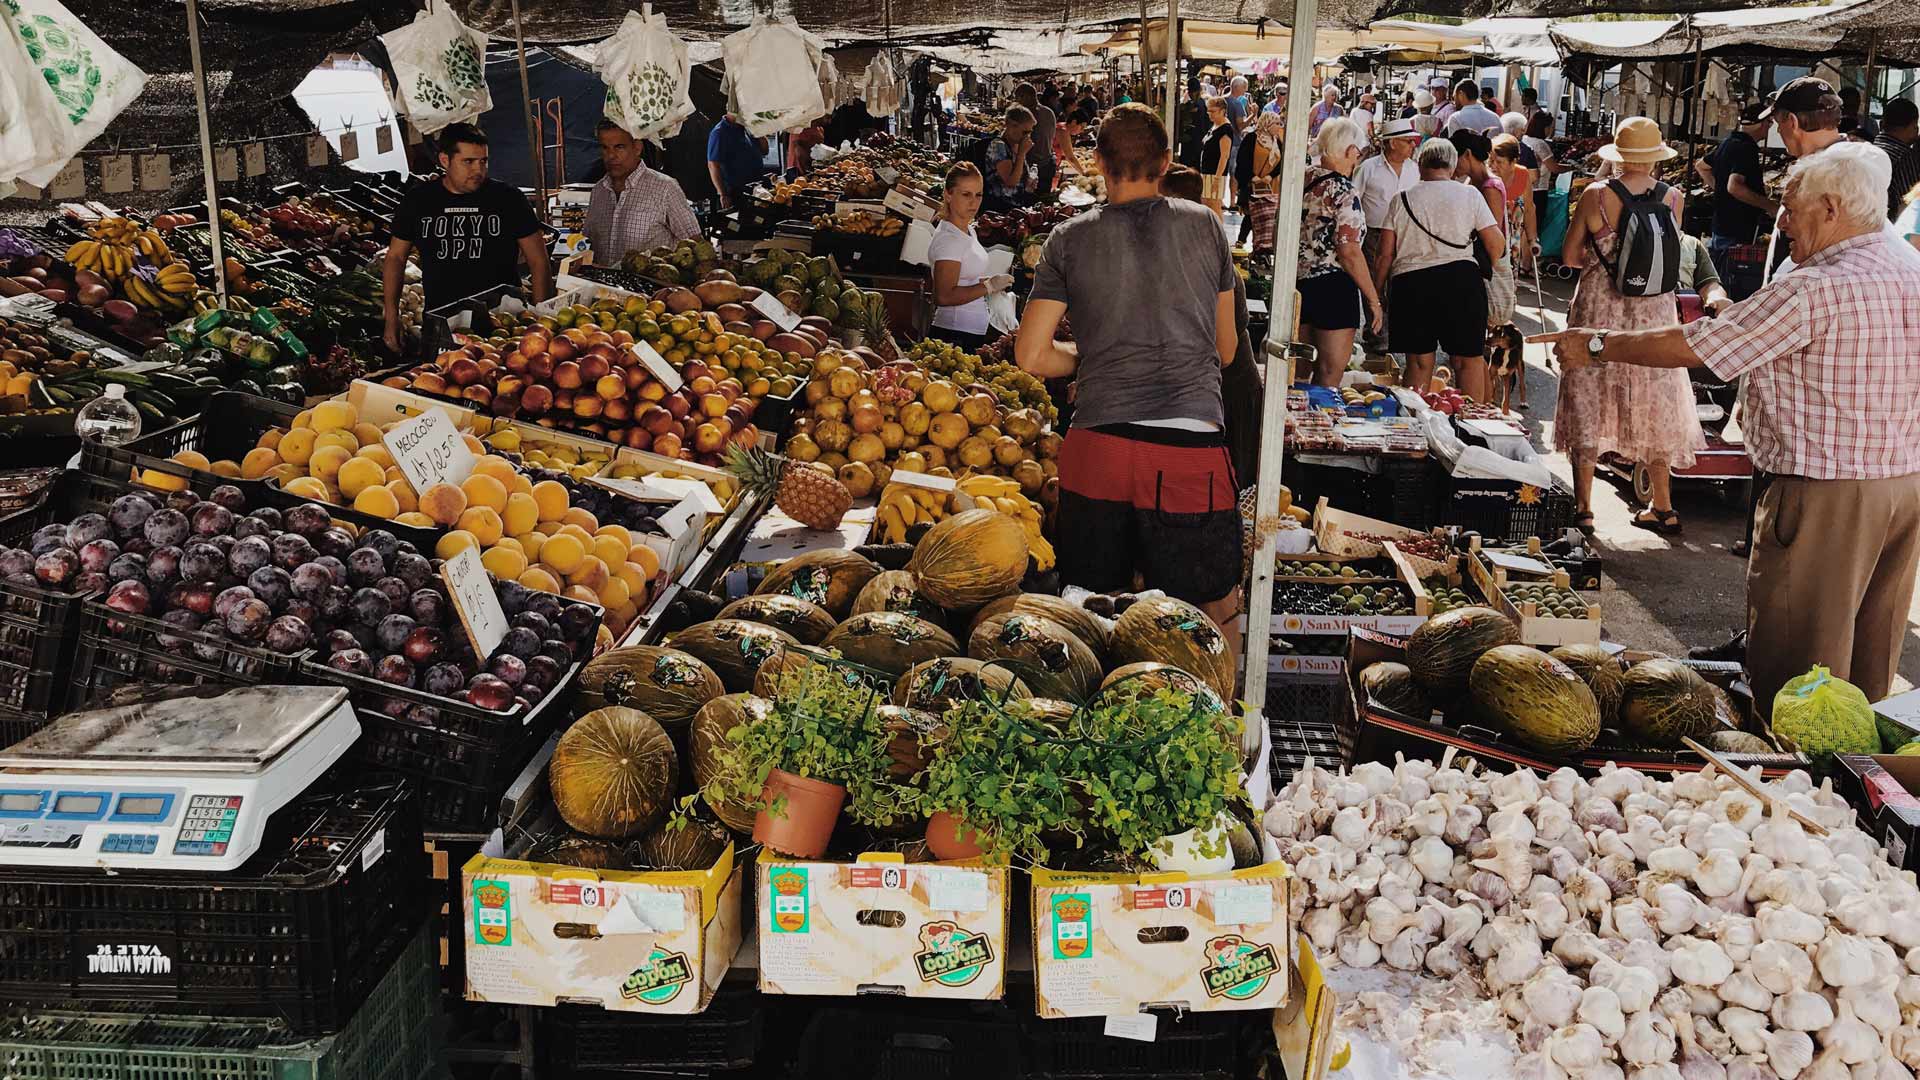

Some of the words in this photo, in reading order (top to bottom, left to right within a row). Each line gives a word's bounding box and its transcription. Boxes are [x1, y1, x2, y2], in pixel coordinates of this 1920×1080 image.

[421, 214, 501, 238] TOKYO
[436, 238, 483, 260] JPN
[1306, 619, 1332, 630] San
[1305, 659, 1328, 670] San
[192, 808, 198, 816] 4
[204, 808, 210, 816] 5
[216, 809, 222, 817] 6
[212, 820, 218, 828] 3
[184, 830, 191, 838] 0
[116, 944, 162, 956] VALE
[924, 942, 986, 972] copón
[1210, 954, 1272, 987] copón
